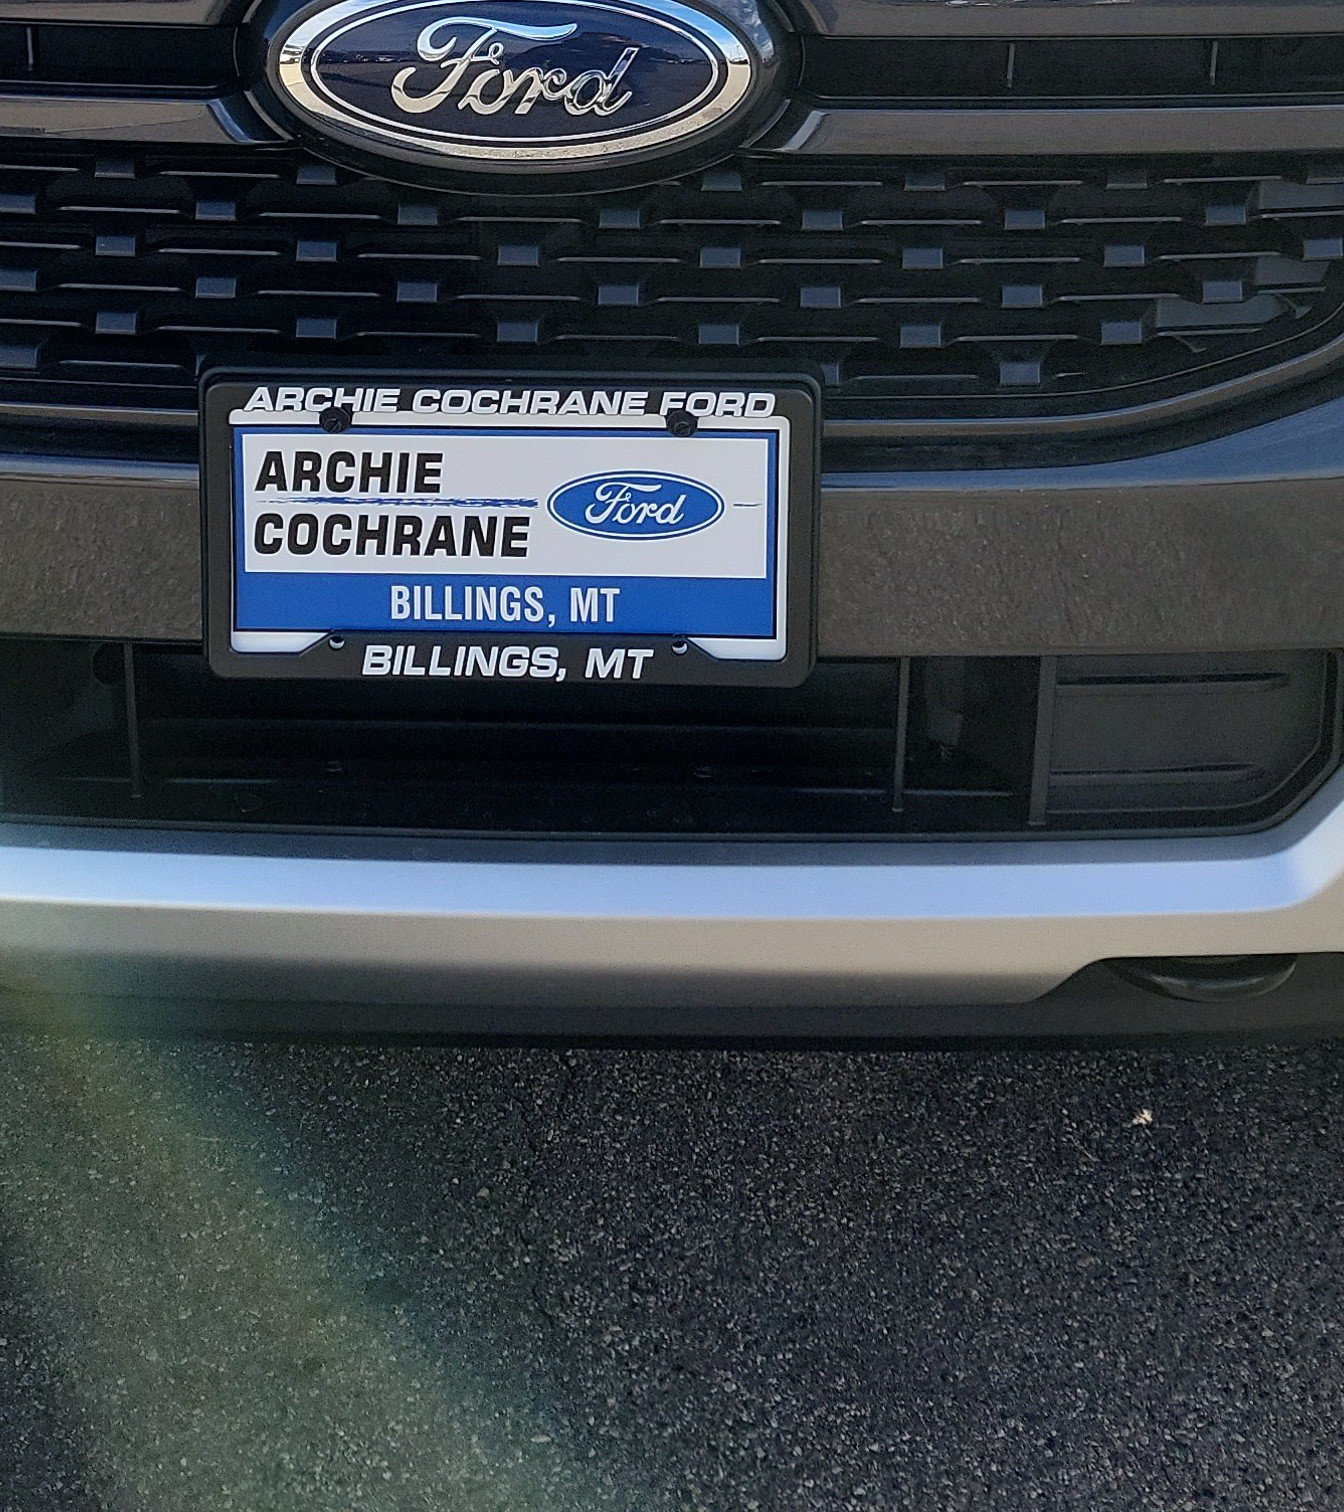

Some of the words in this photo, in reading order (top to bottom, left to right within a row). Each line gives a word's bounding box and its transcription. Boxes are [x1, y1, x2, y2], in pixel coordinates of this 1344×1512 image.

[392, 17, 638, 116] Ford
[244, 387, 400, 413] ARCHIE
[412, 389, 646, 416] COCHRANE
[659, 392, 776, 418] FORD
[255, 450, 444, 494] ARCHIE
[585, 482, 684, 525] Ford
[254, 512, 531, 558] COCHRANE
[390, 585, 556, 628] BILLINGS,
[570, 587, 621, 623] MT
[361, 645, 567, 682] BILLINGS,
[584, 648, 654, 680] MT
